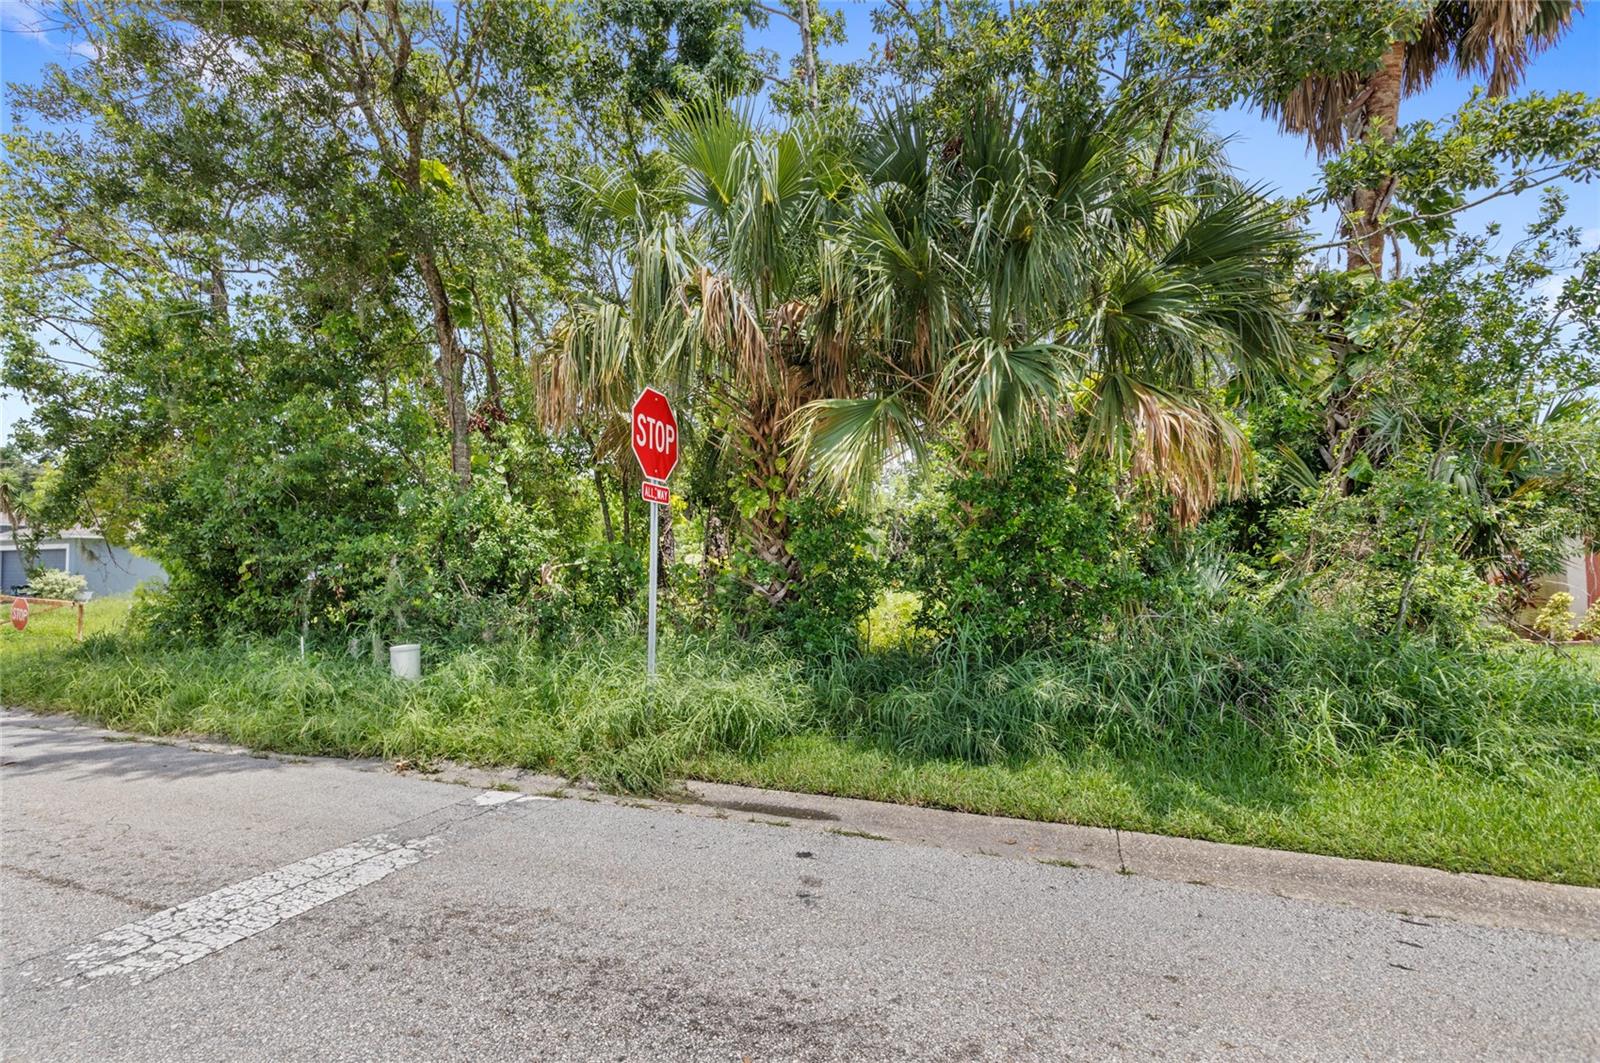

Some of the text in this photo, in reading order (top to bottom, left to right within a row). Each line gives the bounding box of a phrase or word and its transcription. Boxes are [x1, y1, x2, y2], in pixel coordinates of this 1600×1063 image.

[636, 413, 675, 454] STOP
[644, 486, 668, 501] ALL WAY
[12, 607, 28, 621] STOP
